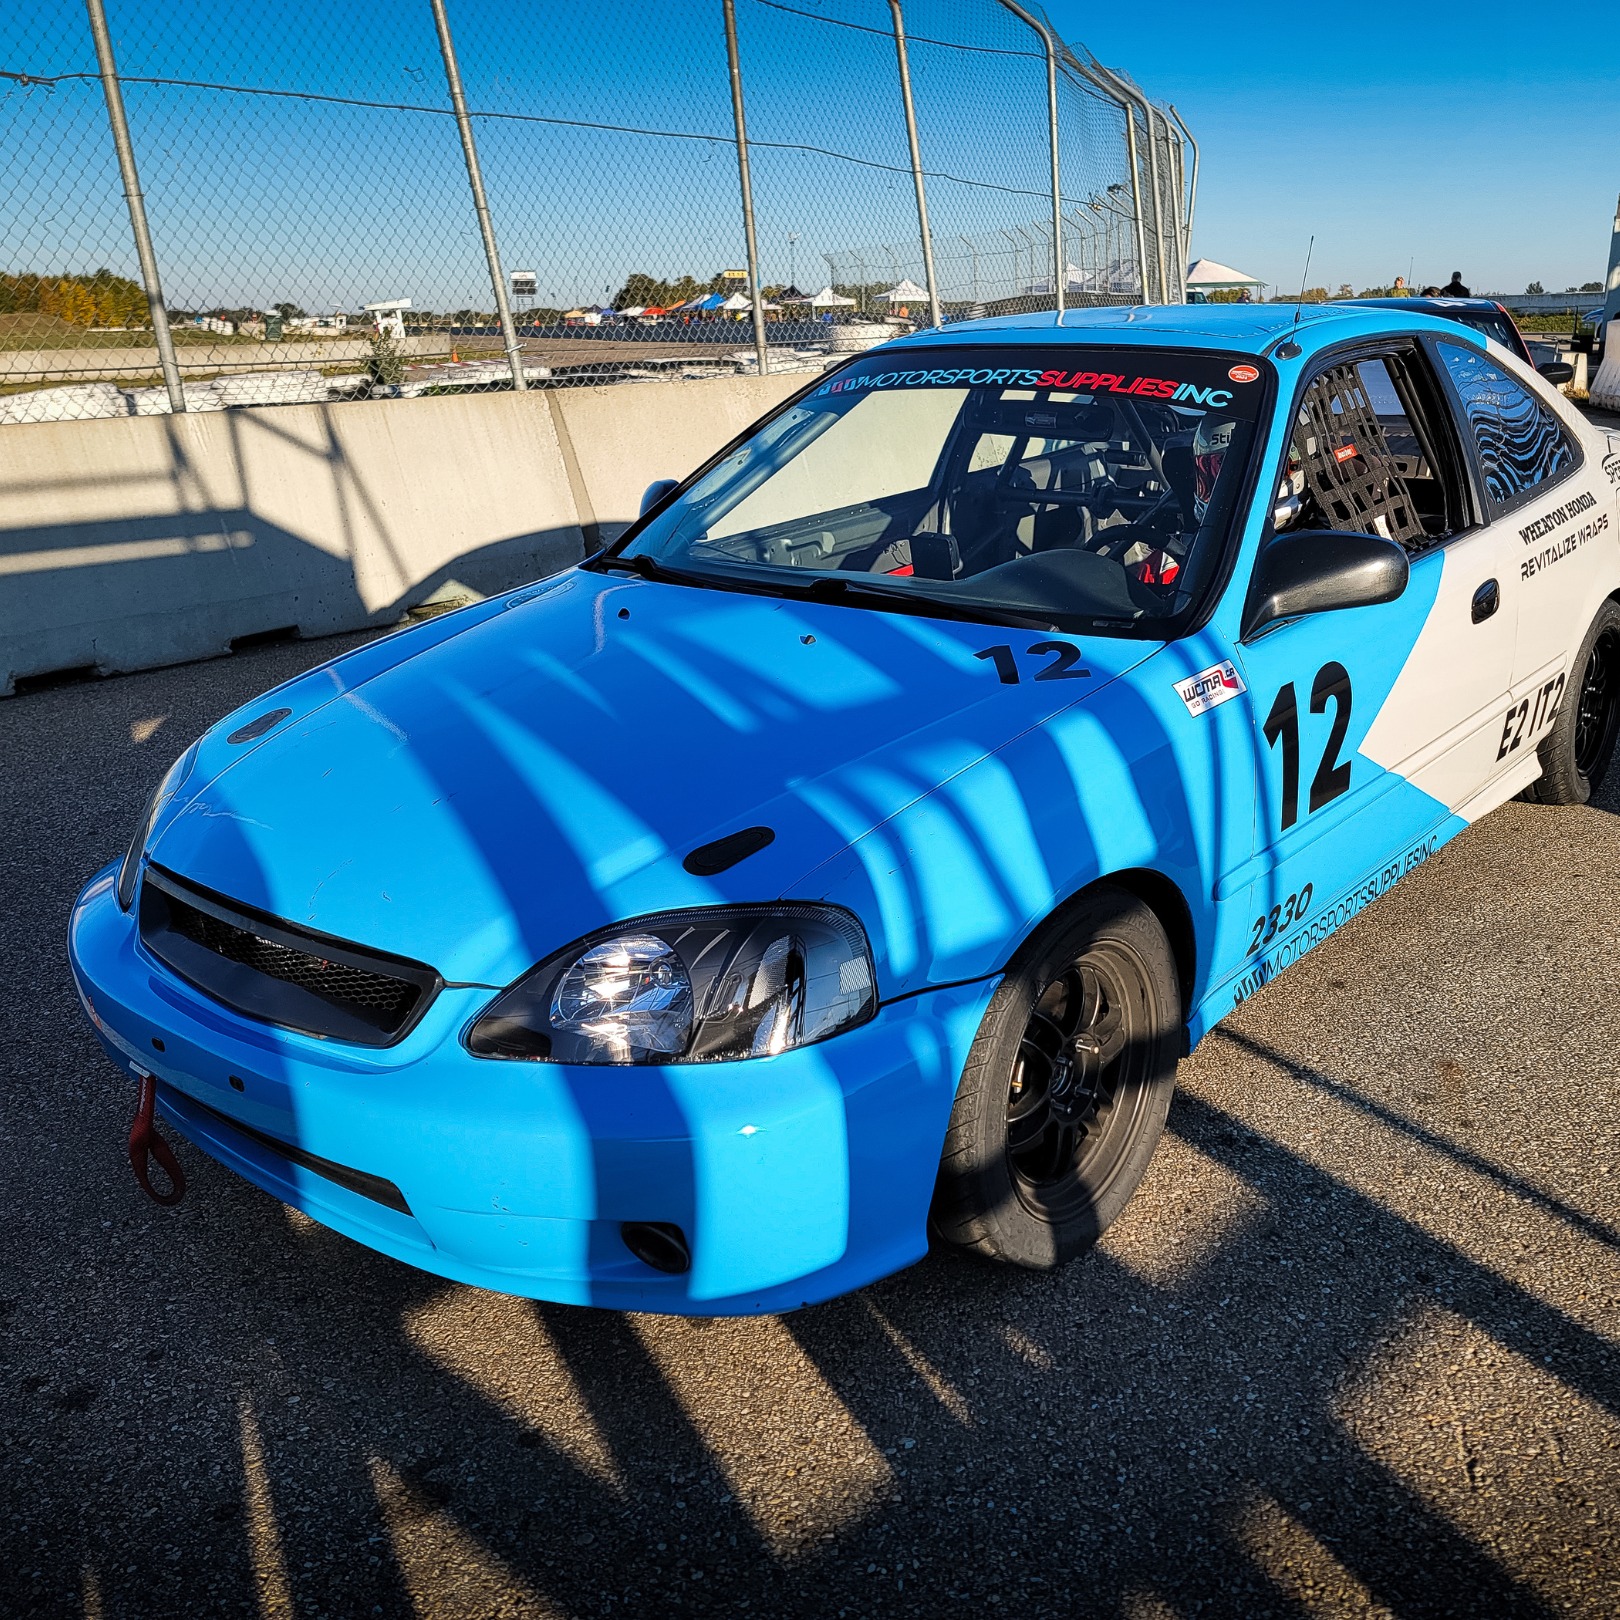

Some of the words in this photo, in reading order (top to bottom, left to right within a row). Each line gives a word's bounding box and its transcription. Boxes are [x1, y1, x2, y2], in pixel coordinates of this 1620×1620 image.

[1518, 505, 1569, 546] WHEATON
[1565, 491, 1598, 519] HONDA
[1520, 533, 1577, 581] REVITALIZE
[1577, 513, 1610, 546] WRAPS
[972, 640, 1092, 685] 12
[1183, 674, 1222, 703] WCMA
[1191, 700, 1201, 709] GO
[1495, 698, 1529, 763] E2
[1527, 672, 1565, 738] IT2
[1263, 661, 1352, 832] 12
[1246, 882, 1313, 958] 2330
